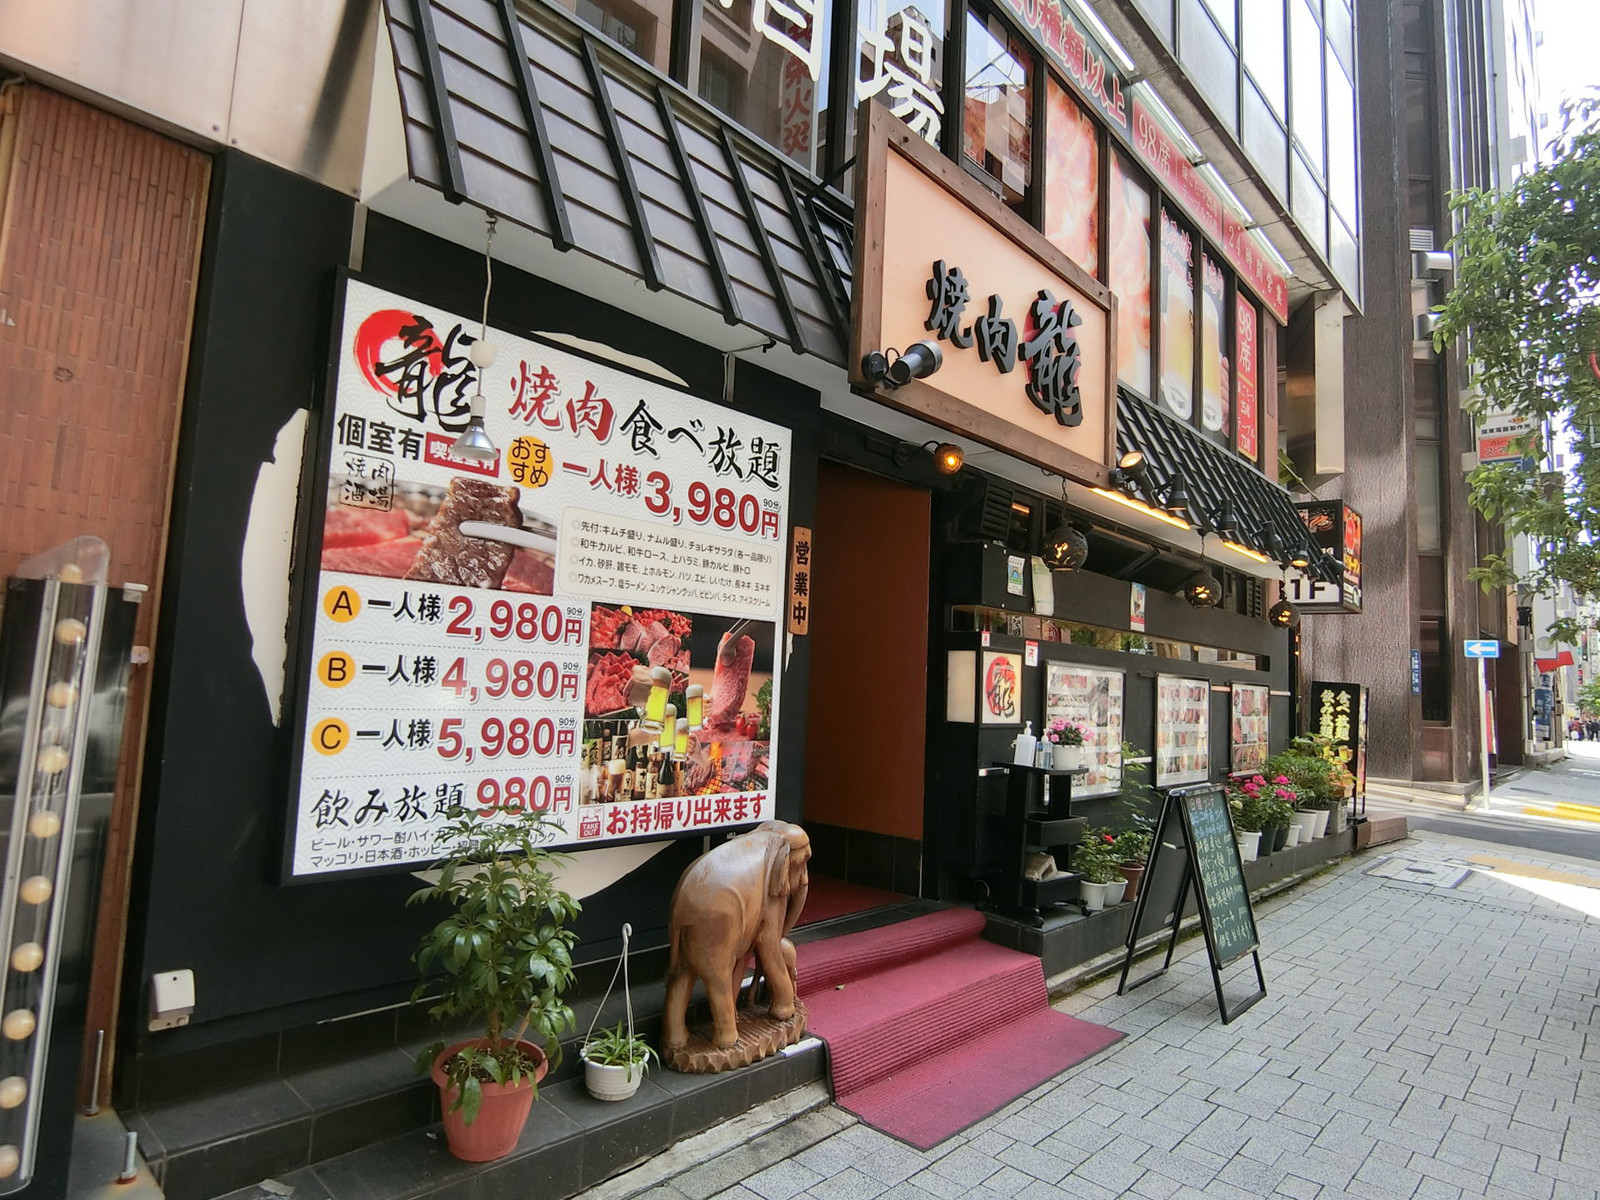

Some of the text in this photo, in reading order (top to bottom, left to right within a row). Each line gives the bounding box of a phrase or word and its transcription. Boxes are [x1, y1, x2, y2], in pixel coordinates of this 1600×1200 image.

[1008, 0, 1127, 129] 0種類以上
[337, 413, 424, 461] 個室有
[792, 540, 810, 626] 営業中
[331, 590, 582, 646] A 一人様 2,980円
[328, 655, 579, 702] B 一人様 4,980円
[1335, 690, 1352, 741] 食べ放題
[320, 724, 342, 749] C
[356, 718, 432, 748] 一人様
[437, 717, 575, 763] 5,980円
[310, 782, 465, 828] 飲み放題
[476, 775, 572, 818] 980円
[605, 792, 766, 836] お持帰り出来ます
[582, 822, 600, 830] TAKE
[583, 828, 598, 837] OUT
